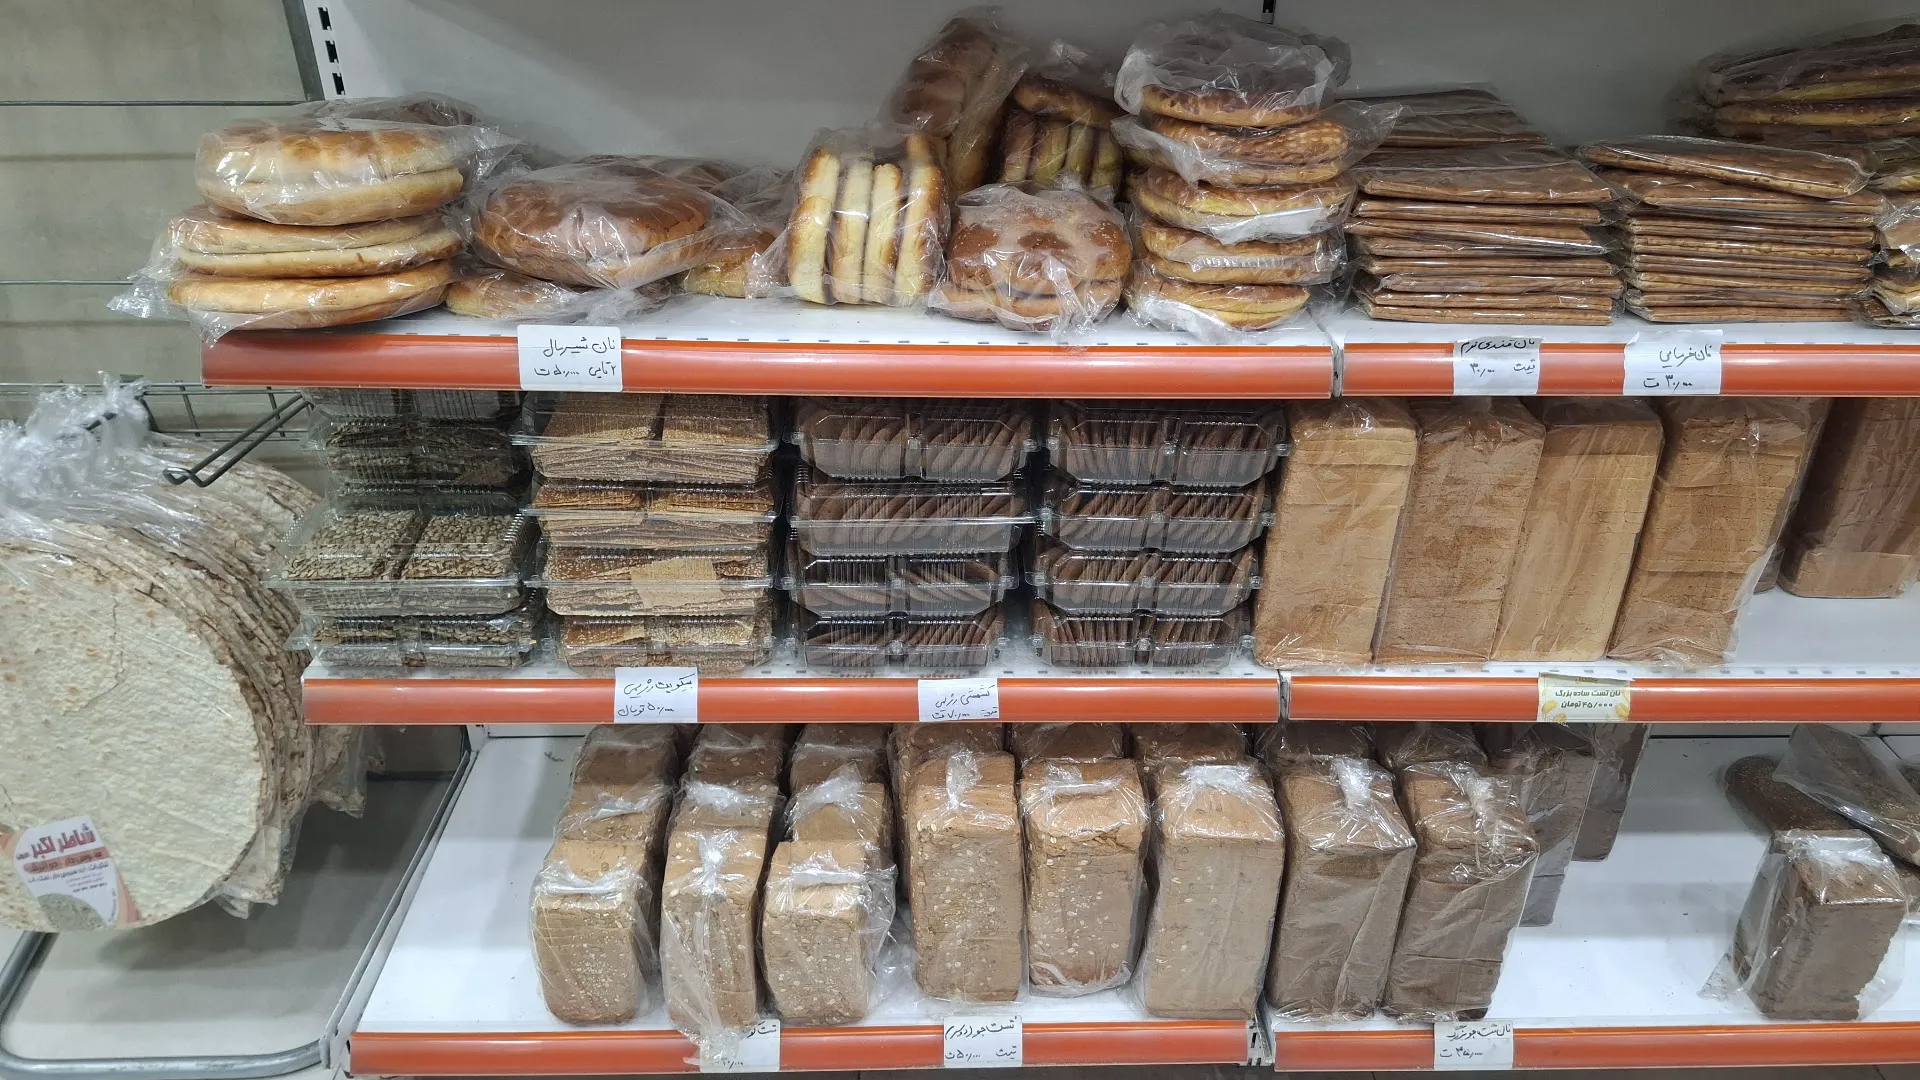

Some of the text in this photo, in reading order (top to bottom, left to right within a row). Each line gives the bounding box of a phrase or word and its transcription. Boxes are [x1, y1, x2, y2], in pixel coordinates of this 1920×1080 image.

[543, 336, 616, 357] نان شیرمال
[1513, 338, 1535, 349] نان
[1694, 343, 1712, 361] نان
[1555, 689, 1621, 698] نان تست ساده بزرگ
[1561, 700, 1582, 708] تومان
[30, 823, 96, 859] شاطر اکبر
